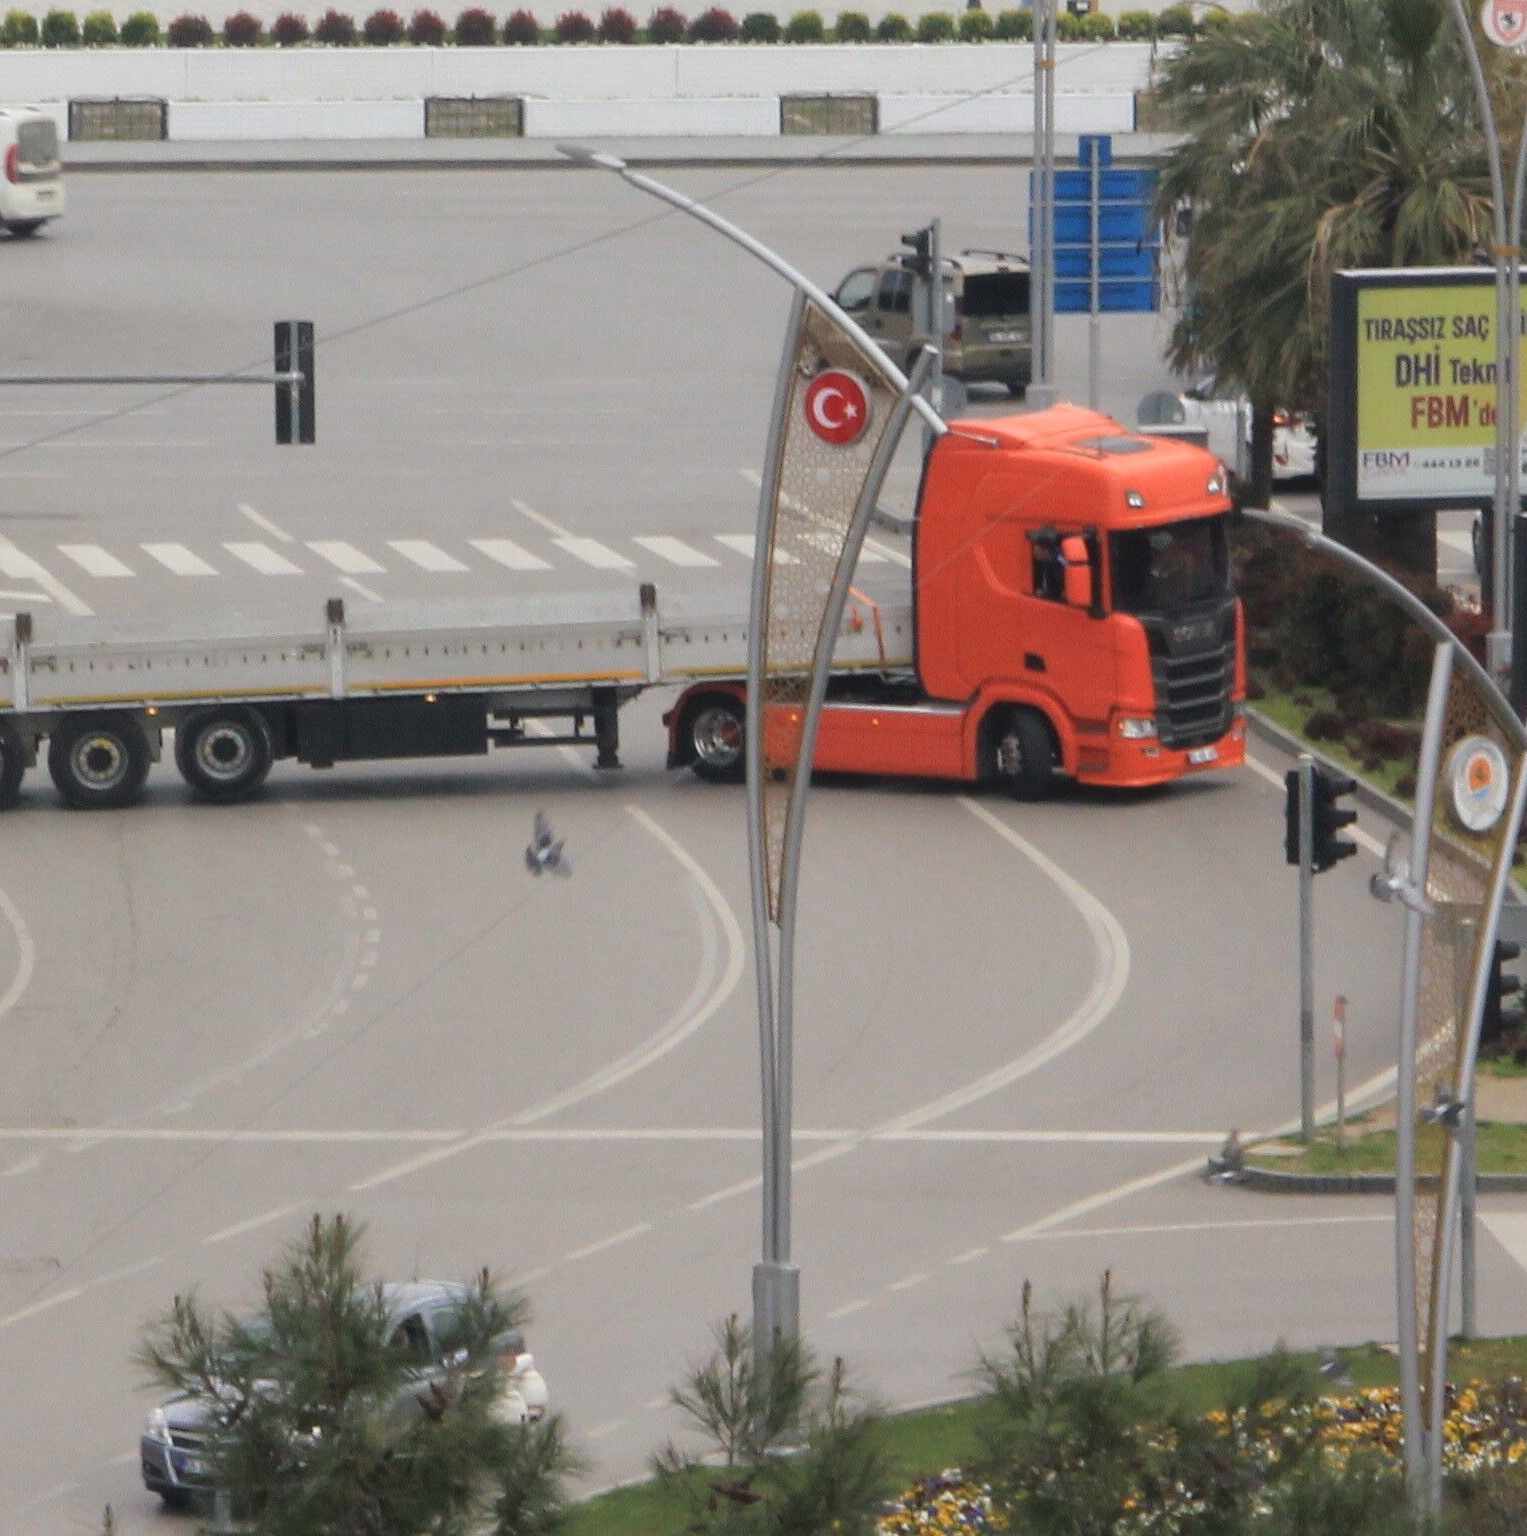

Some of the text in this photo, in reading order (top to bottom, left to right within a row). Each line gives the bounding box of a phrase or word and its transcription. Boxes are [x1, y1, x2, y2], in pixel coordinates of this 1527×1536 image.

[1365, 317, 1445, 343] TIRAŞSIZ
[1453, 315, 1489, 340] SAÇ
[1364, 452, 1410, 468] FBM
